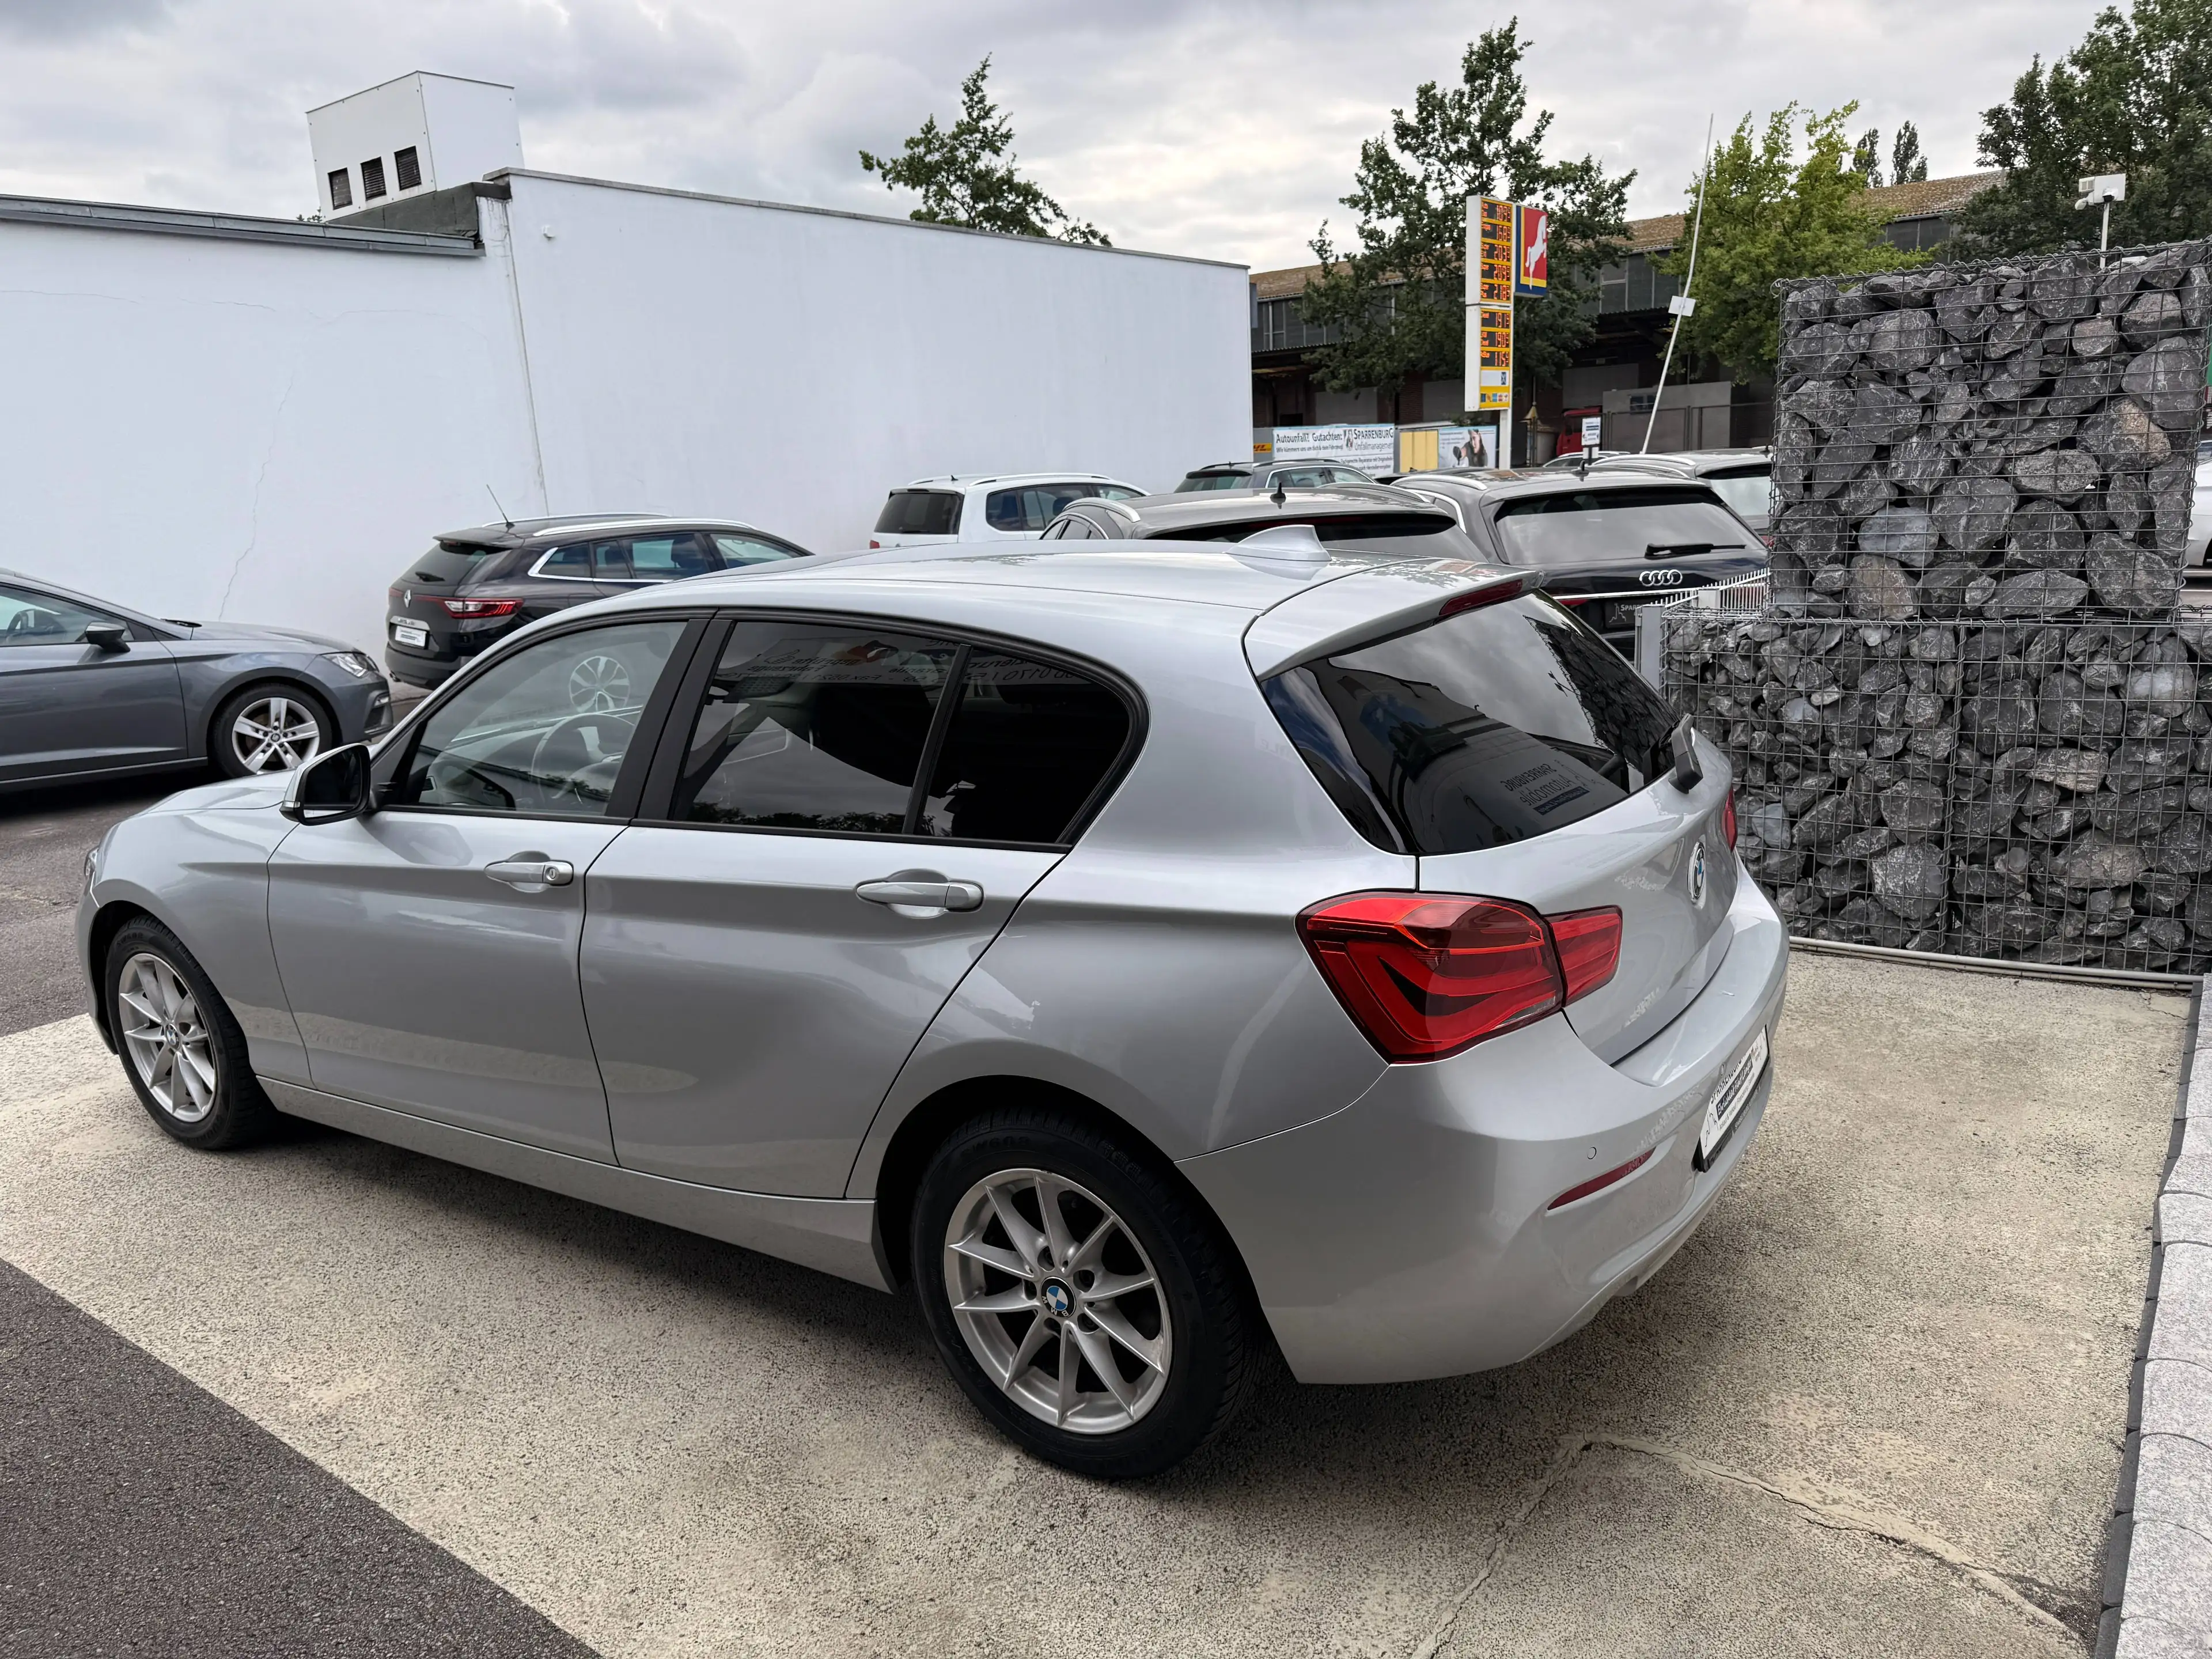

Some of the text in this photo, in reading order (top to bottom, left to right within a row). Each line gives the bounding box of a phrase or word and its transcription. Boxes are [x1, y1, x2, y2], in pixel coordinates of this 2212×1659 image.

[1276, 431, 1342, 443] Autounfall? Gutachten:
[1354, 428, 1393, 440] SPARRENBURG
[1041, 1296, 1069, 1317] BMW
